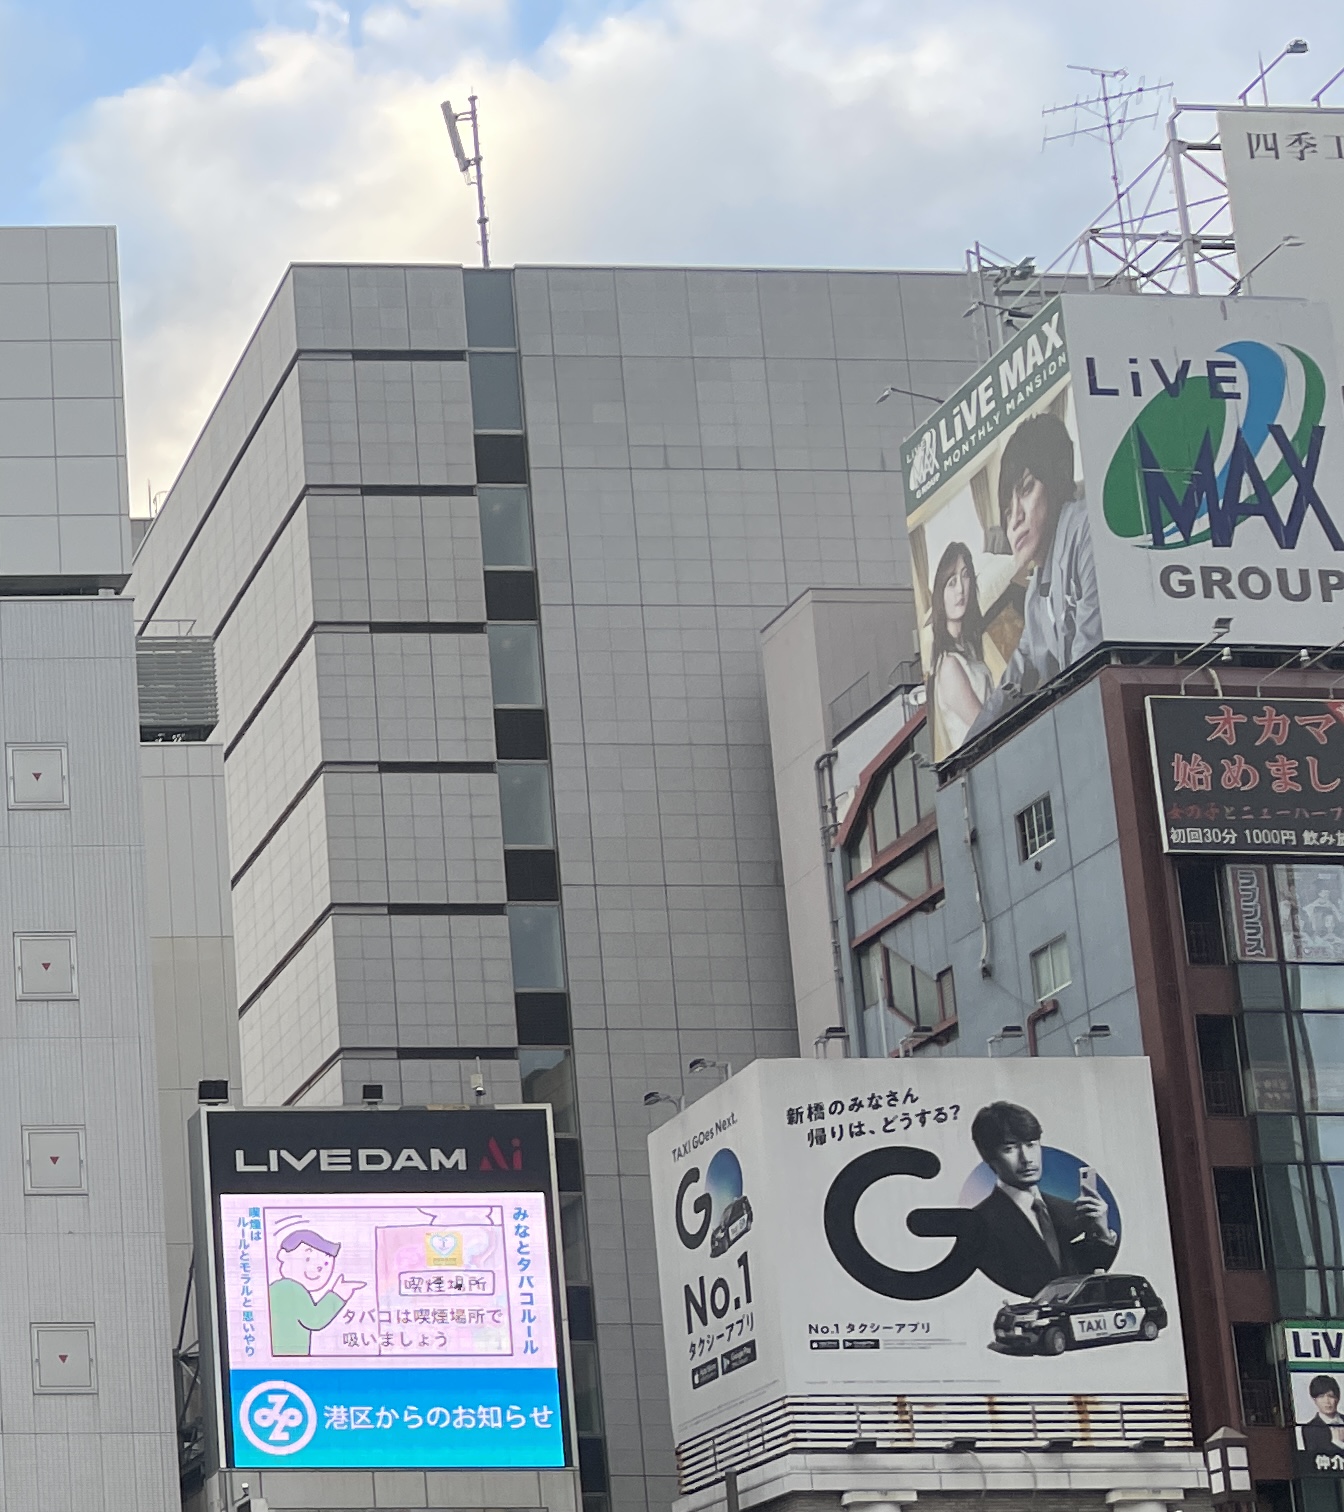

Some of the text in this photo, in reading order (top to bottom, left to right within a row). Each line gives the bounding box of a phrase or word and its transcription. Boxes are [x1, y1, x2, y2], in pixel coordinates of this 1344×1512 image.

[996, 312, 1065, 399] MAX
[943, 352, 1068, 471] MONTHLY MANSION
[1160, 564, 1344, 603] GROUP
[1204, 704, 1337, 746] オカマ
[1171, 752, 1341, 793] 始めまし
[1170, 826, 1238, 845] 初回30分
[1245, 829, 1298, 846] 1000円
[786, 1087, 919, 1127] 新橋のみなさん
[248, 1207, 262, 1241] 喫煙は
[404, 1274, 487, 1293] 喫煙場所
[513, 1206, 539, 1356] みなとタバコルール
[683, 1251, 752, 1335] No.1
[343, 1307, 503, 1326] タバコは喫煙場所で
[808, 1321, 931, 1335] No.1 タクシーアプリ
[1078, 1319, 1108, 1335] TAXI
[343, 1330, 449, 1348] 吸いましょう
[689, 1312, 755, 1362] タクシーアプリ
[323, 1404, 554, 1431] 港区からのお知らせ
